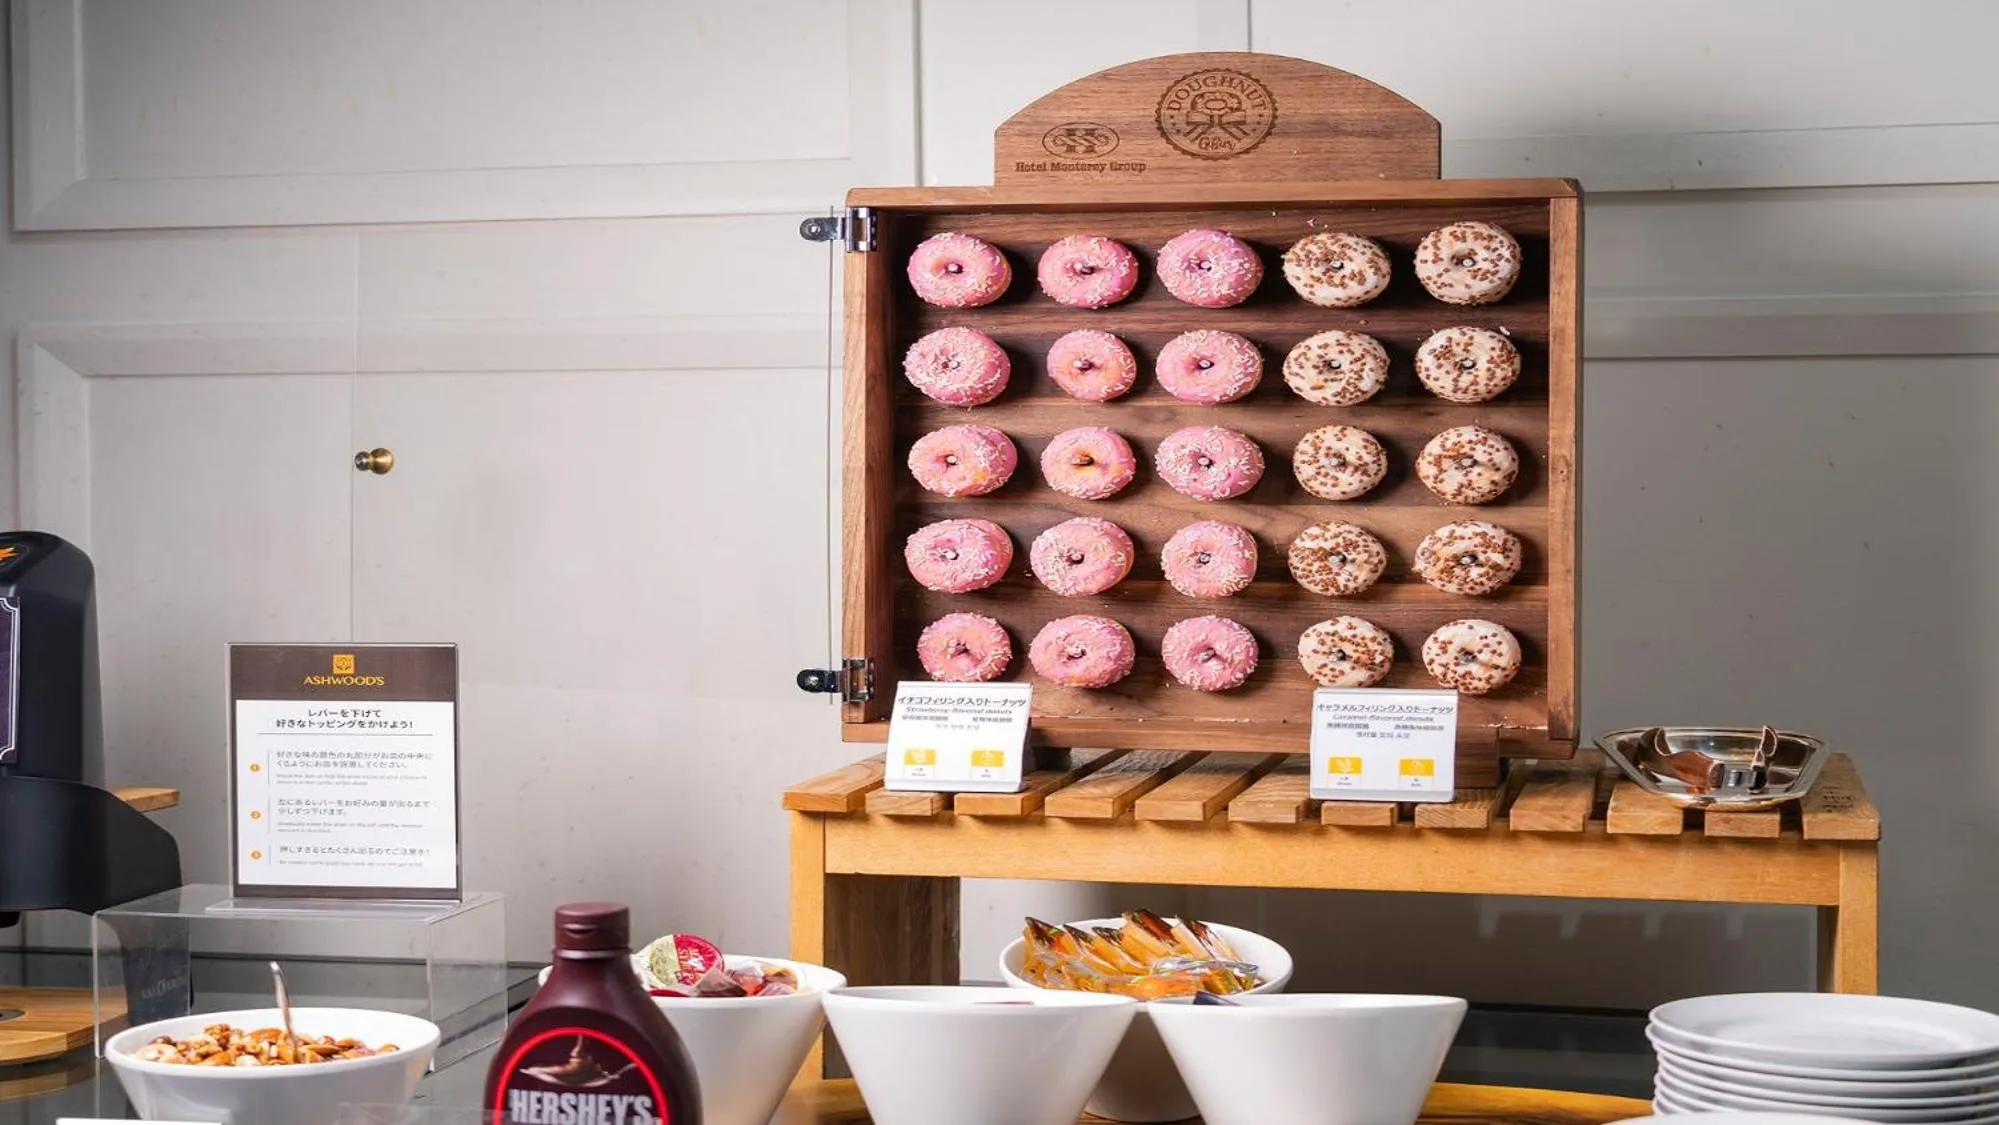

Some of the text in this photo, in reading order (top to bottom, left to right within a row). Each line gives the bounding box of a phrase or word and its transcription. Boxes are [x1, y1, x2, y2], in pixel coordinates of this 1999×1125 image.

[1167, 75, 1267, 112] DOUGHNUT
[1015, 161, 1147, 174] Hotel Monterey Group
[308, 709, 382, 718] レバーを下げて
[508, 1088, 653, 1125] HERSHEY'S
